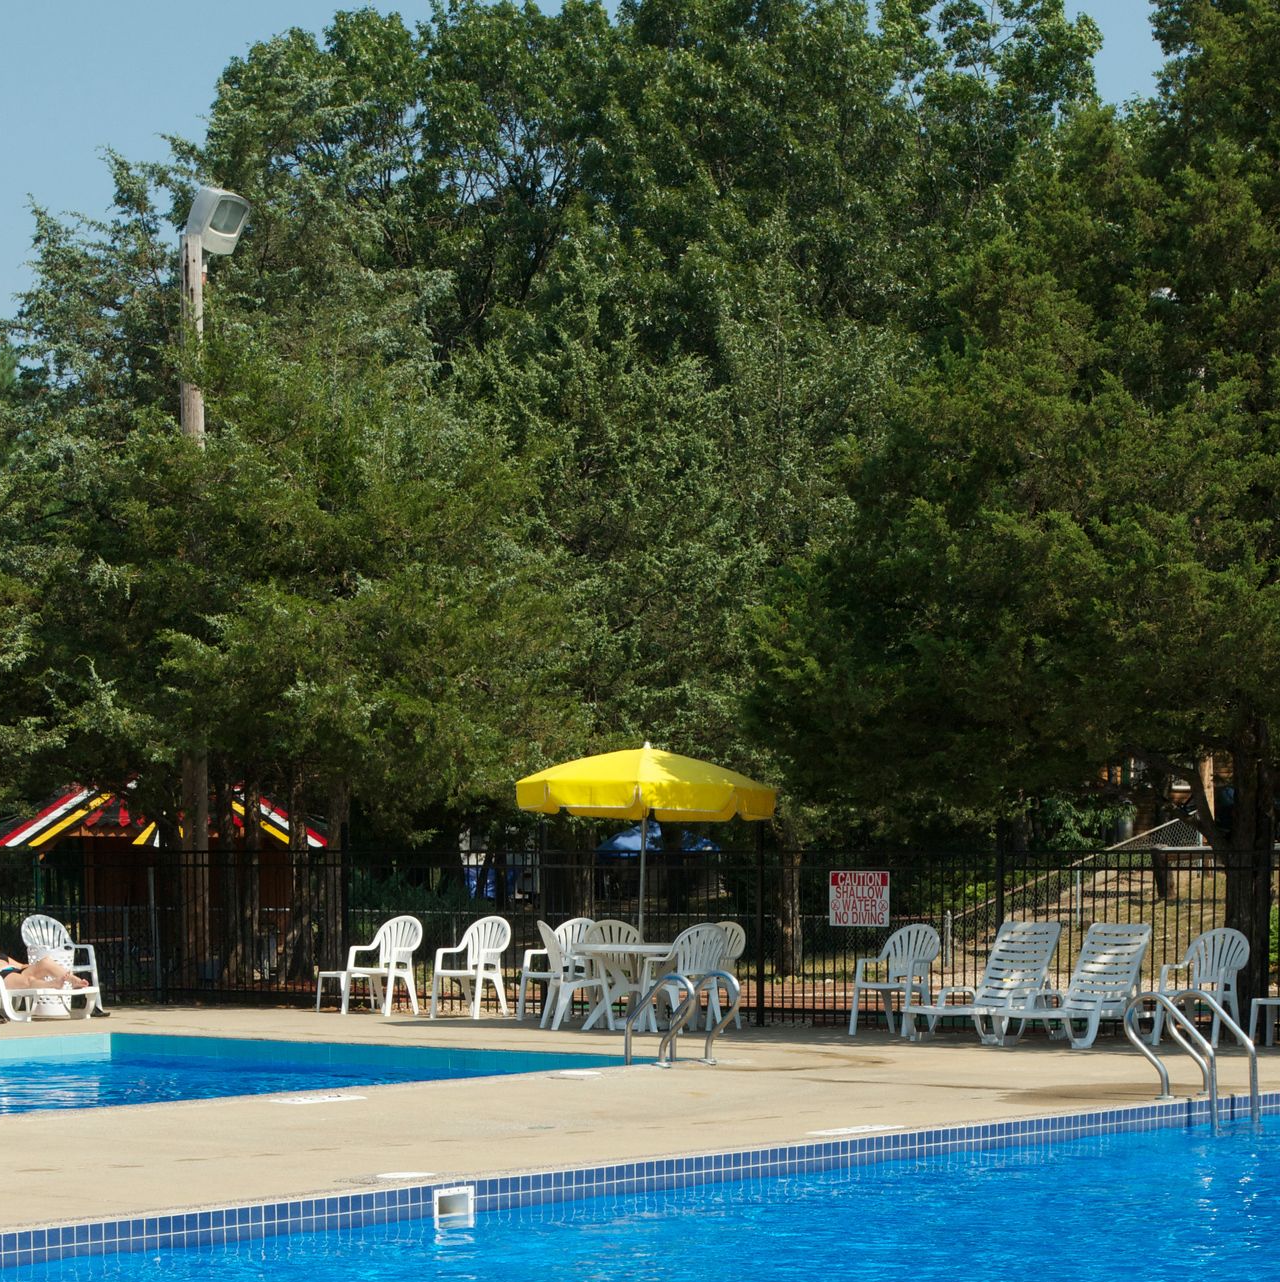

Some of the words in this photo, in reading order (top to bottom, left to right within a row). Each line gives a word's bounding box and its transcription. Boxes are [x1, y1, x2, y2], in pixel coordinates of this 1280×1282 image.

[838, 873, 881, 886] CAUTION
[835, 886, 883, 899] SHALLOW
[842, 899, 877, 911] WATER
[835, 911, 848, 924] NO
[852, 911, 885, 925] DIVING
